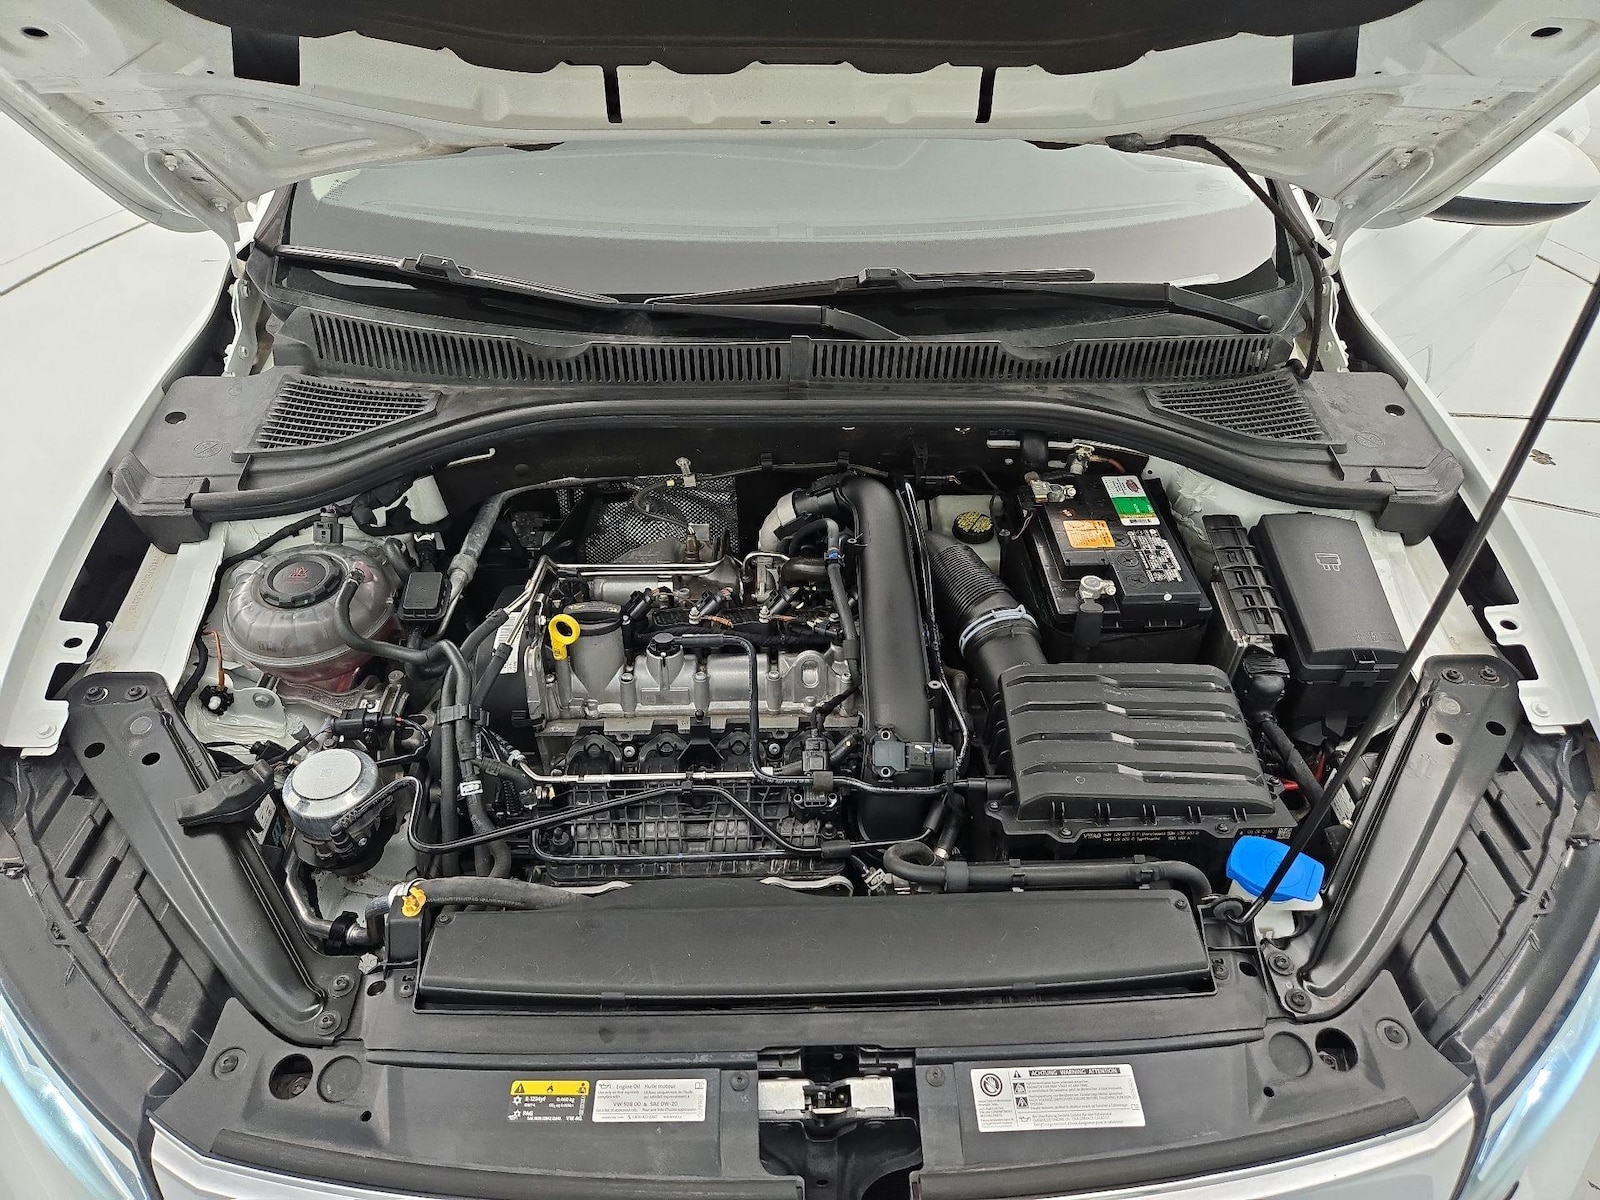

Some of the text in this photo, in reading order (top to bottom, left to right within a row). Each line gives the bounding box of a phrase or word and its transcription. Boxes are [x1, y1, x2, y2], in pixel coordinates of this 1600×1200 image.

[1031, 1069, 1058, 1077] ACHTUNG
[1088, 1067, 1117, 1075] ATTENTION
[616, 1083, 632, 1091] Engine
